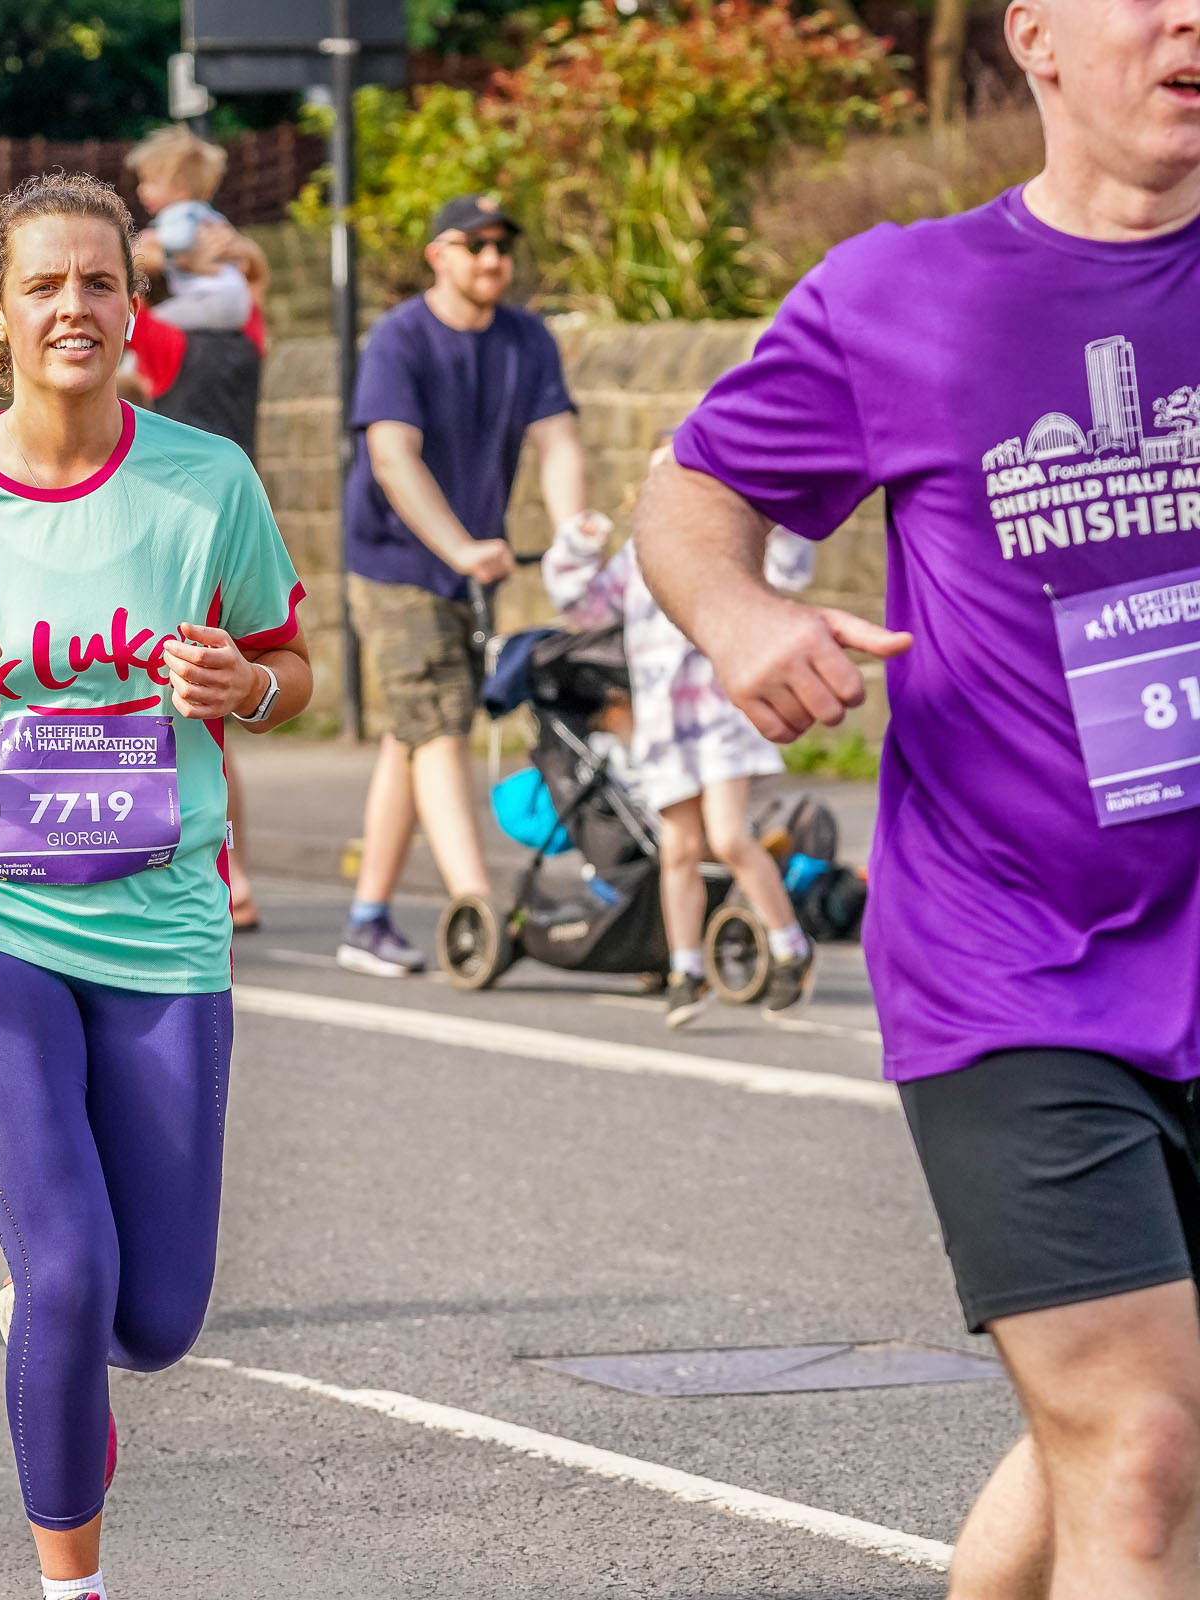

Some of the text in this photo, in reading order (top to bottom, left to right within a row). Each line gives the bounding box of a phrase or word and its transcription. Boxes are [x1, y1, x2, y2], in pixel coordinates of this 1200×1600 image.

[986, 455, 1142, 497] ASDA Foundation
[989, 479, 1104, 519] SHEFFIELD
[1106, 470, 1167, 496] HALF
[995, 492, 1200, 560] FINISHER
[37, 727, 101, 738] SHEFFIELD
[37, 739, 156, 750] HALF MARATHON
[118, 752, 157, 765] 2022
[29, 790, 134, 824] 7719
[46, 831, 120, 847] GIORGIA
[10, 868, 29, 876] FOR
[30, 867, 47, 876] ALL
